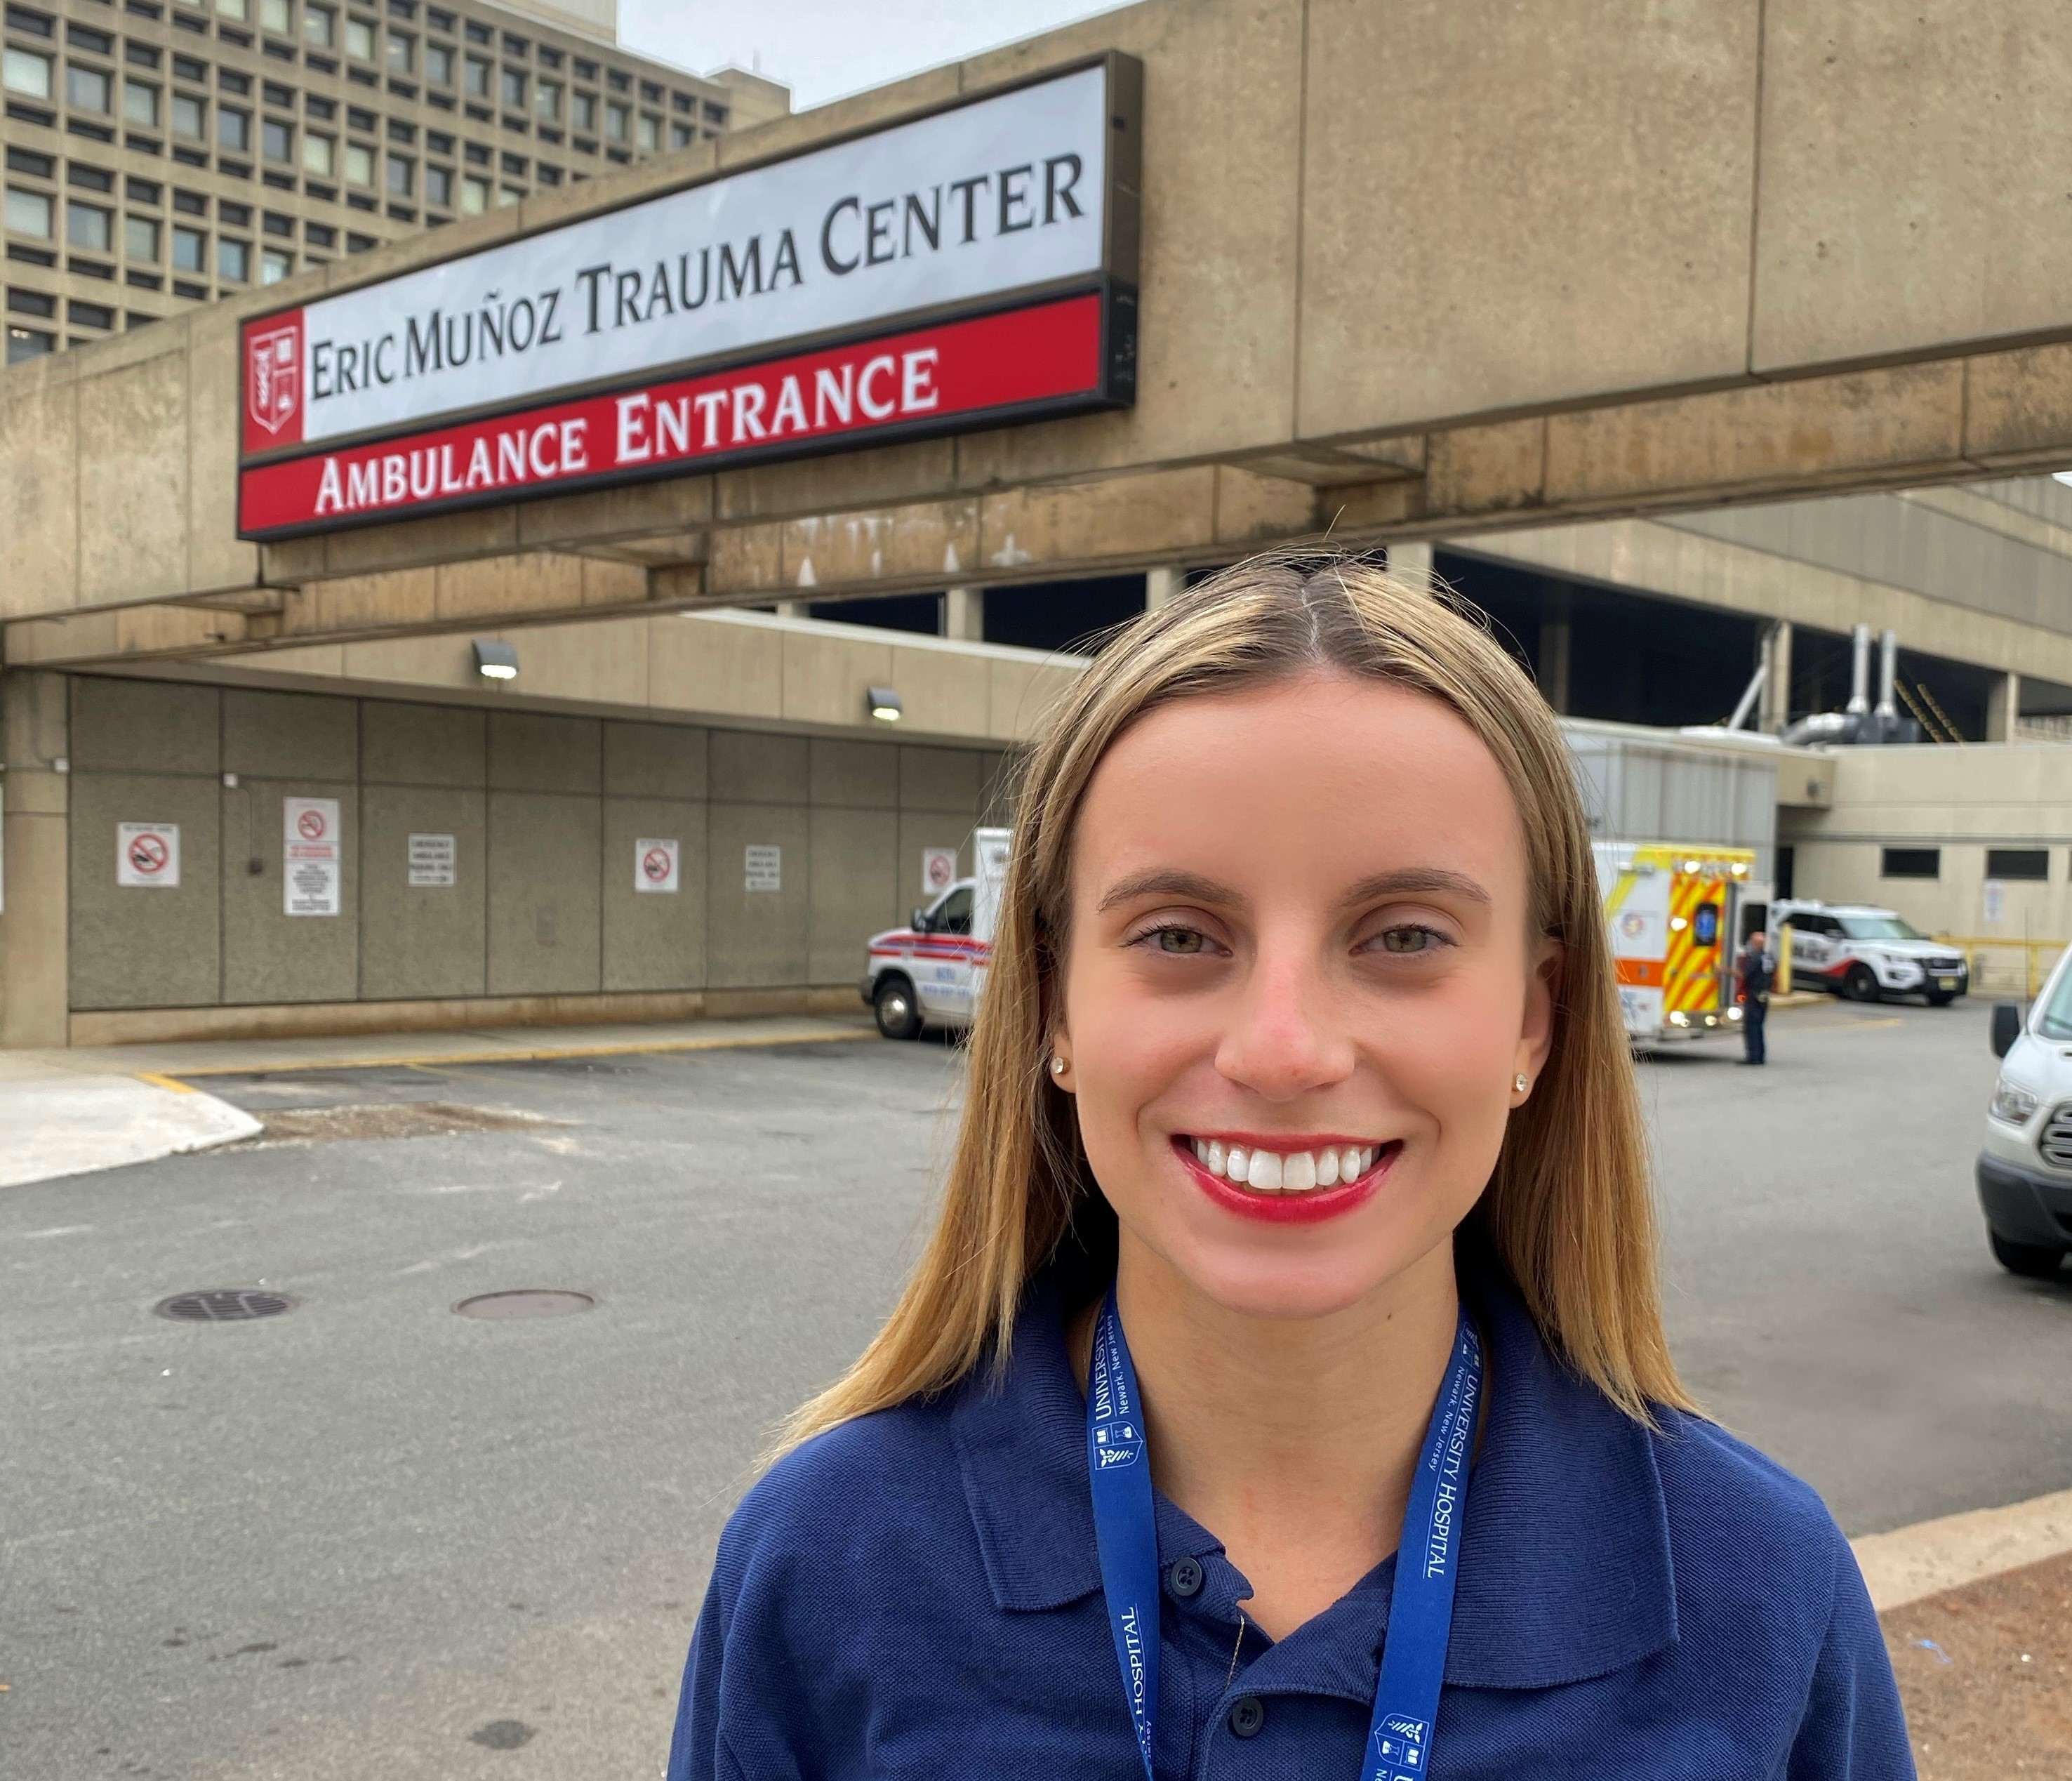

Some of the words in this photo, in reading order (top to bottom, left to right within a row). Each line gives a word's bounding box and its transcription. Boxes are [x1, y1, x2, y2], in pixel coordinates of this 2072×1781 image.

[312, 333, 394, 400] ERIC
[404, 288, 563, 378] MUÑOZ
[576, 226, 804, 336] TRAUMA
[818, 152, 1085, 277] CENTER
[314, 418, 588, 515] AMBULANCE
[615, 347, 939, 465] ENTRANCE
[1107, 1316, 1116, 1346] Jersey
[1111, 1348, 1121, 1370] New
[1095, 1324, 1112, 1420] UNIVERSITY
[1115, 1371, 1129, 1415] Newark,
[1446, 1365, 1466, 1409] Newark,
[1428, 1436, 1446, 1472] Jersey
[1439, 1412, 1456, 1434] New
[1443, 1374, 1477, 1481] UNIVERSITY
[1427, 1482, 1458, 1579] HOSPITAL
[1121, 1606, 1143, 1715] HOSPITAL
